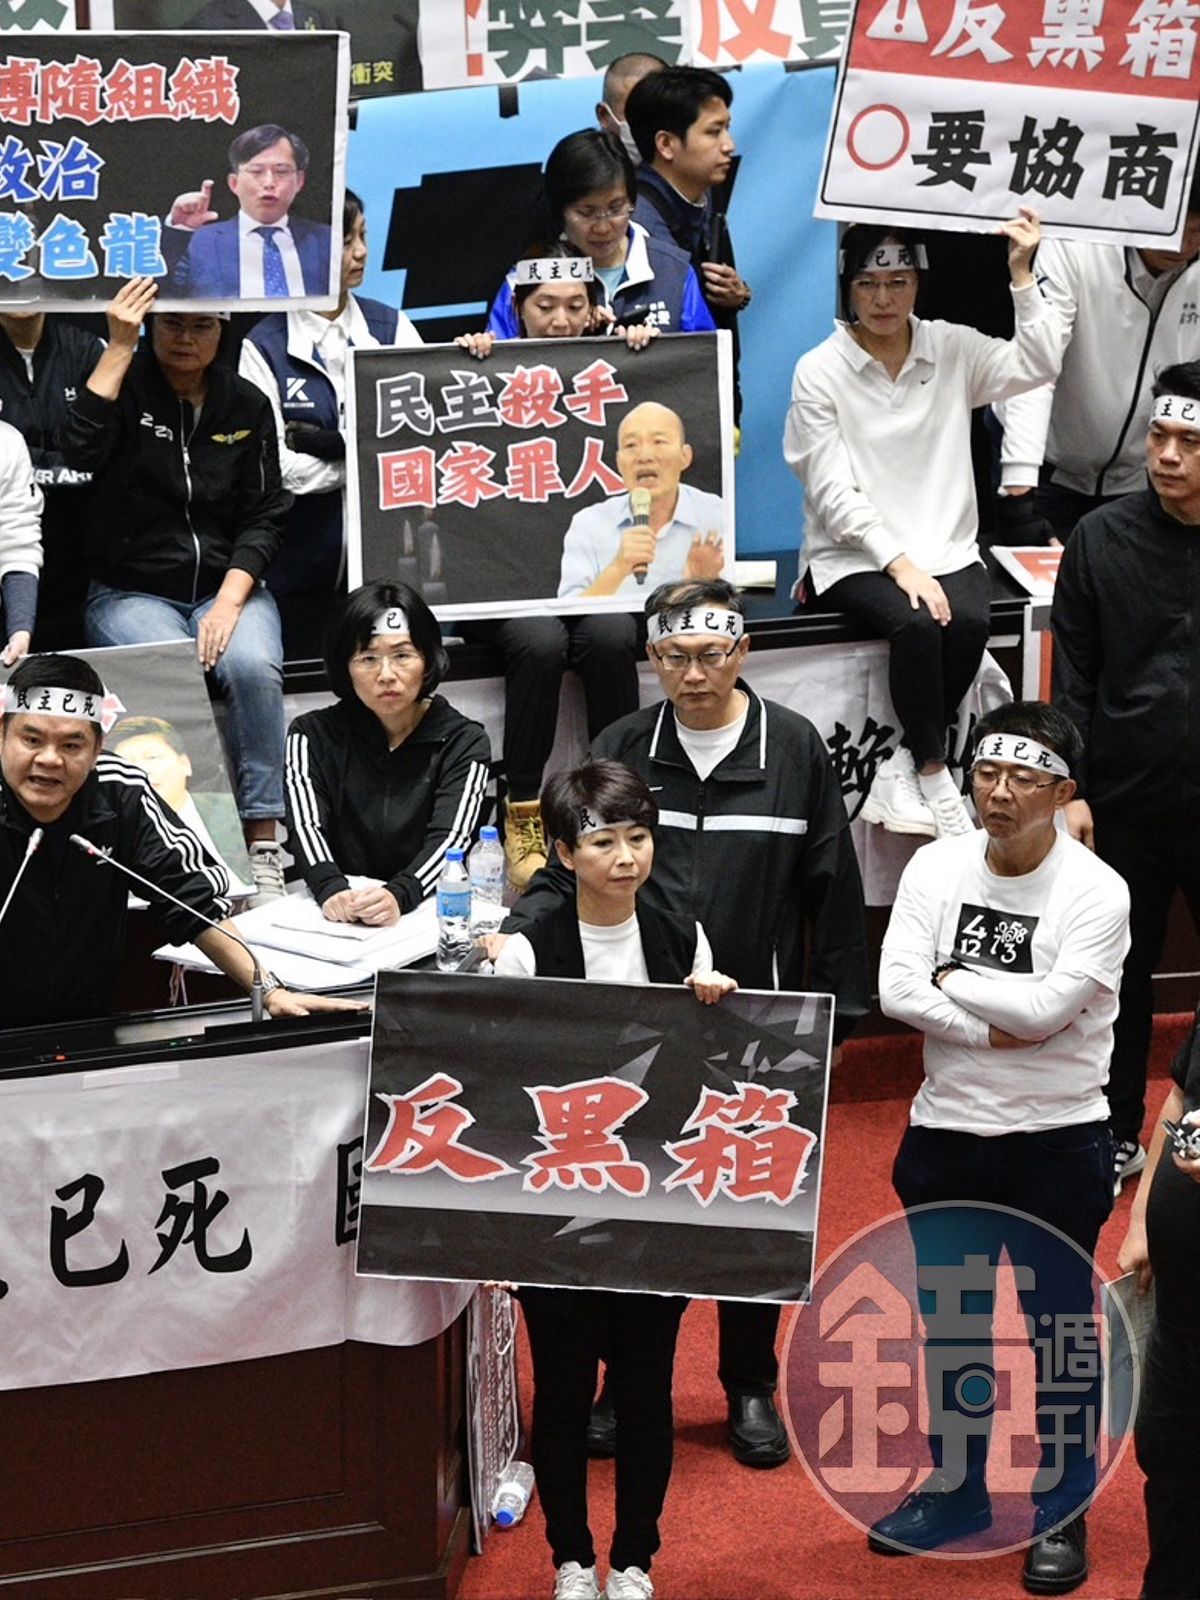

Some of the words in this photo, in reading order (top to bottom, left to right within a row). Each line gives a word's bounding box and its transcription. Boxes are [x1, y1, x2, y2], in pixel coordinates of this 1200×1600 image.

[930, 0, 1199, 80] 反黑箱
[911, 109, 1179, 210] 要協商
[376, 358, 628, 437] 民主殺手
[1153, 398, 1196, 421] 主已
[377, 436, 628, 511] 國家罪人
[658, 611, 737, 635] 民主已死
[17, 690, 95, 717] 民主已死
[365, 1072, 820, 1207] 反黑箱
